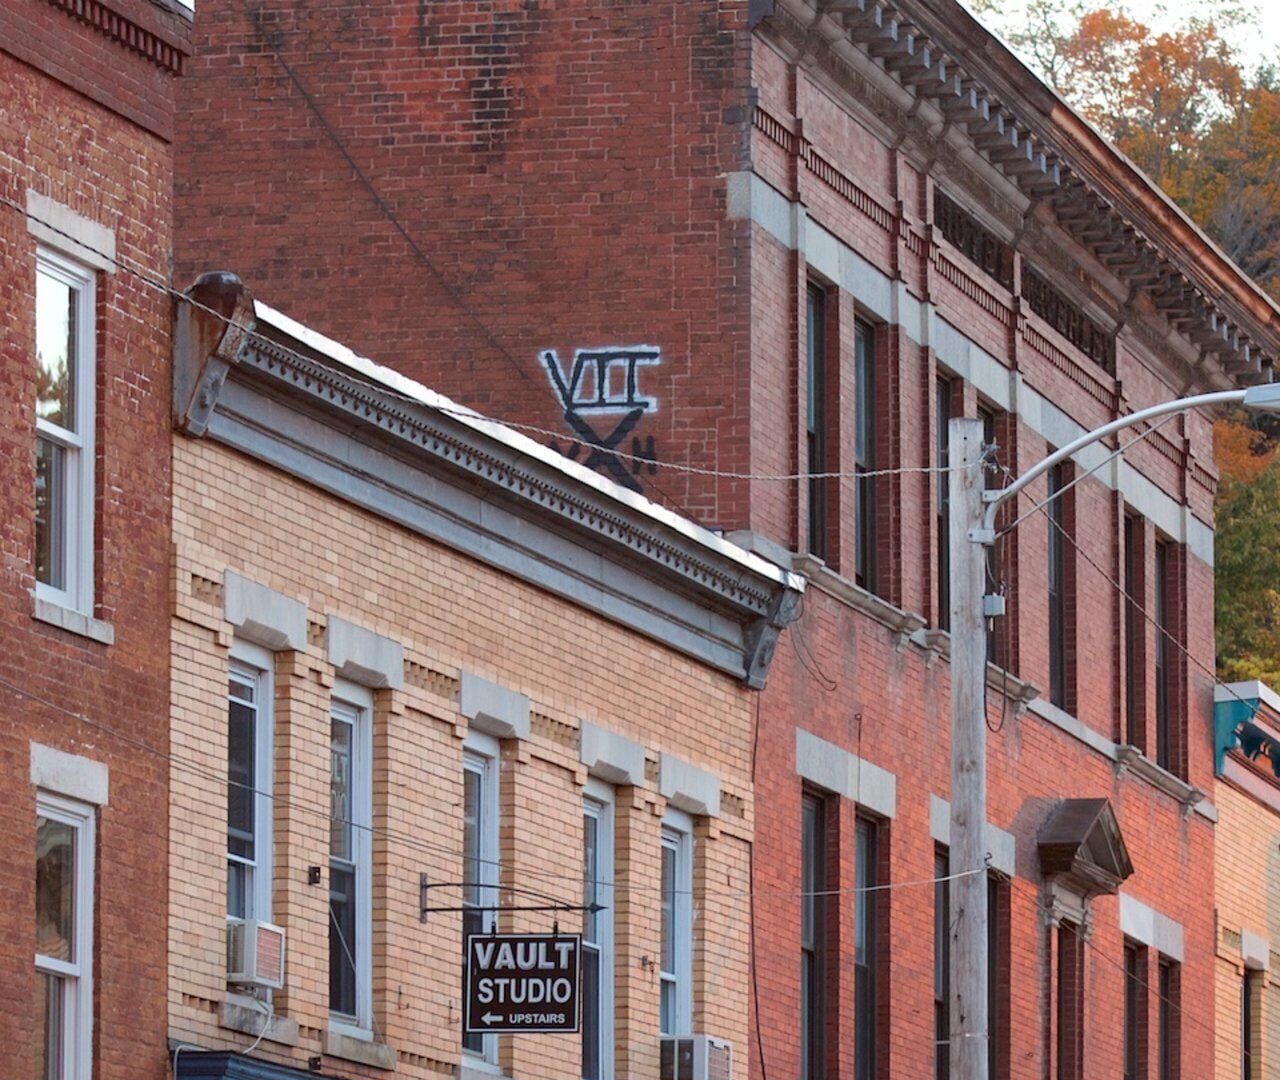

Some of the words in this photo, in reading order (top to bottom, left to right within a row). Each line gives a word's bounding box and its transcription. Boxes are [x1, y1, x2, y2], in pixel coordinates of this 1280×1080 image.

[474, 942, 574, 970] VAULT
[477, 978, 571, 1003] STUDIO
[509, 1013, 565, 1024] UPSTAIRS
